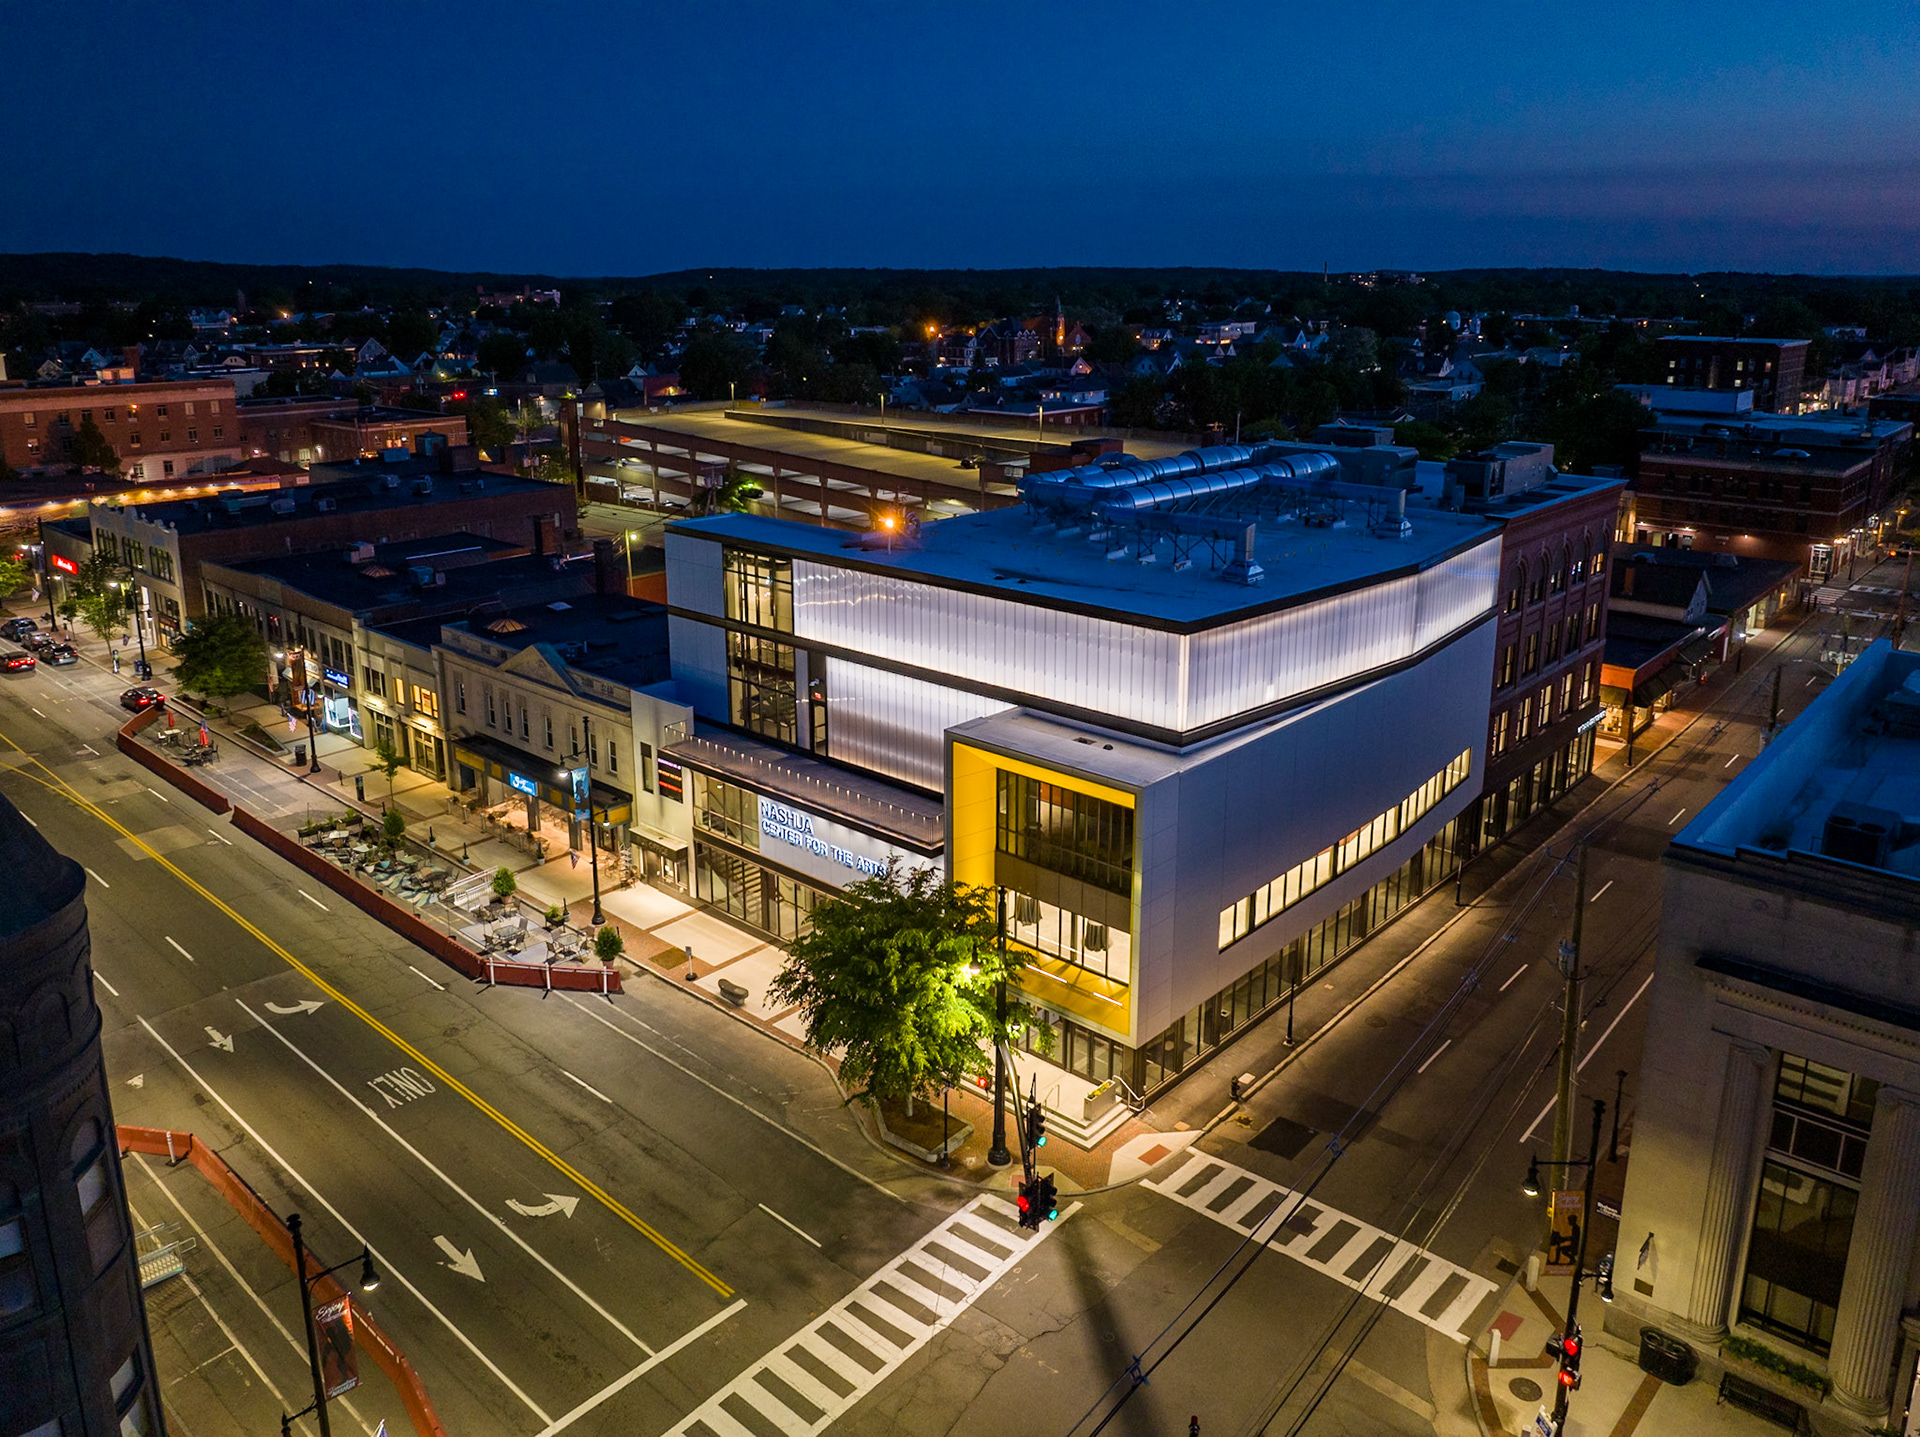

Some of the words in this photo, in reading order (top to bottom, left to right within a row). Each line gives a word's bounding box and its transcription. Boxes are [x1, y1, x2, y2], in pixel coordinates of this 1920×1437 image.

[760, 801, 815, 834] NASHUA
[762, 819, 803, 846] CENTER
[804, 833, 829, 858] FOR
[830, 845, 854, 867] THE
[857, 855, 888, 876] ARTS
[367, 1067, 436, 1109] ONLY
